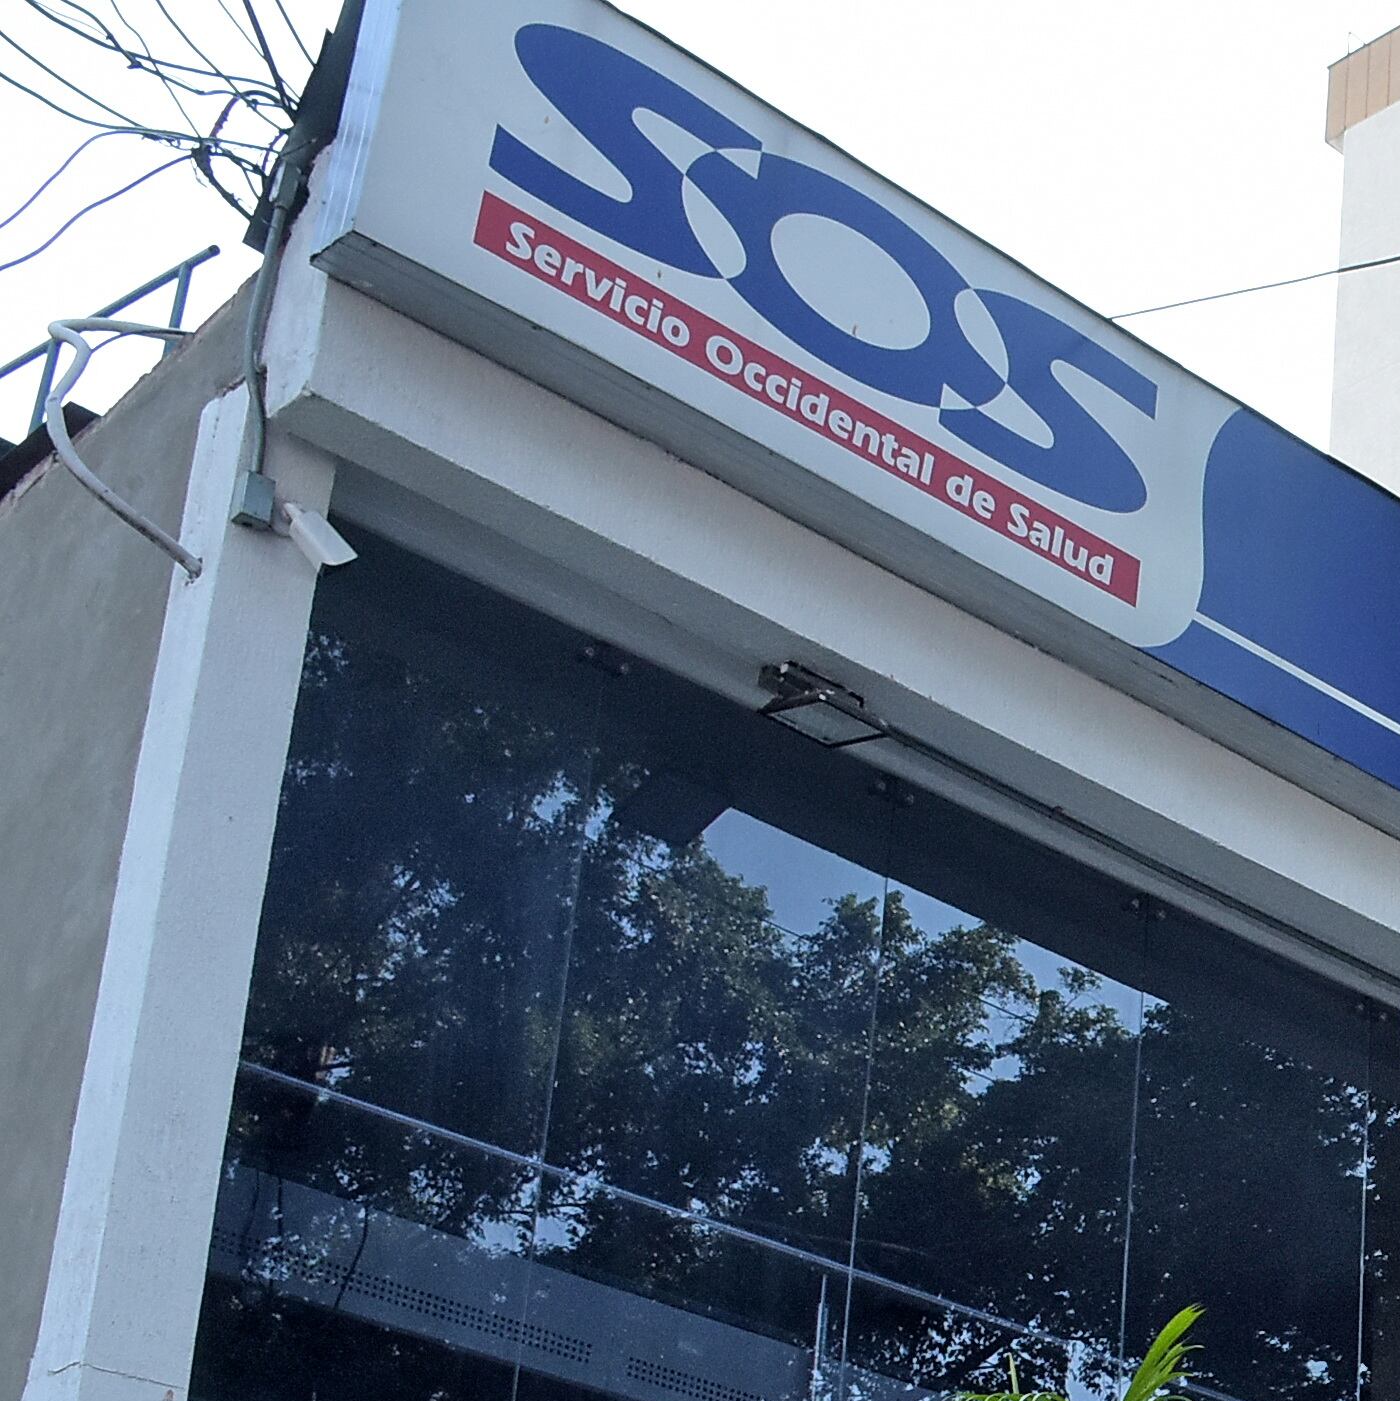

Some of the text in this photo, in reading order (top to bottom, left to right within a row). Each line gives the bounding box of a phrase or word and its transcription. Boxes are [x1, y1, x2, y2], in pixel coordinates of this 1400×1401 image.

[489, 23, 1158, 514] SOS
[506, 221, 1114, 586] Servicio Occidental de Salud
